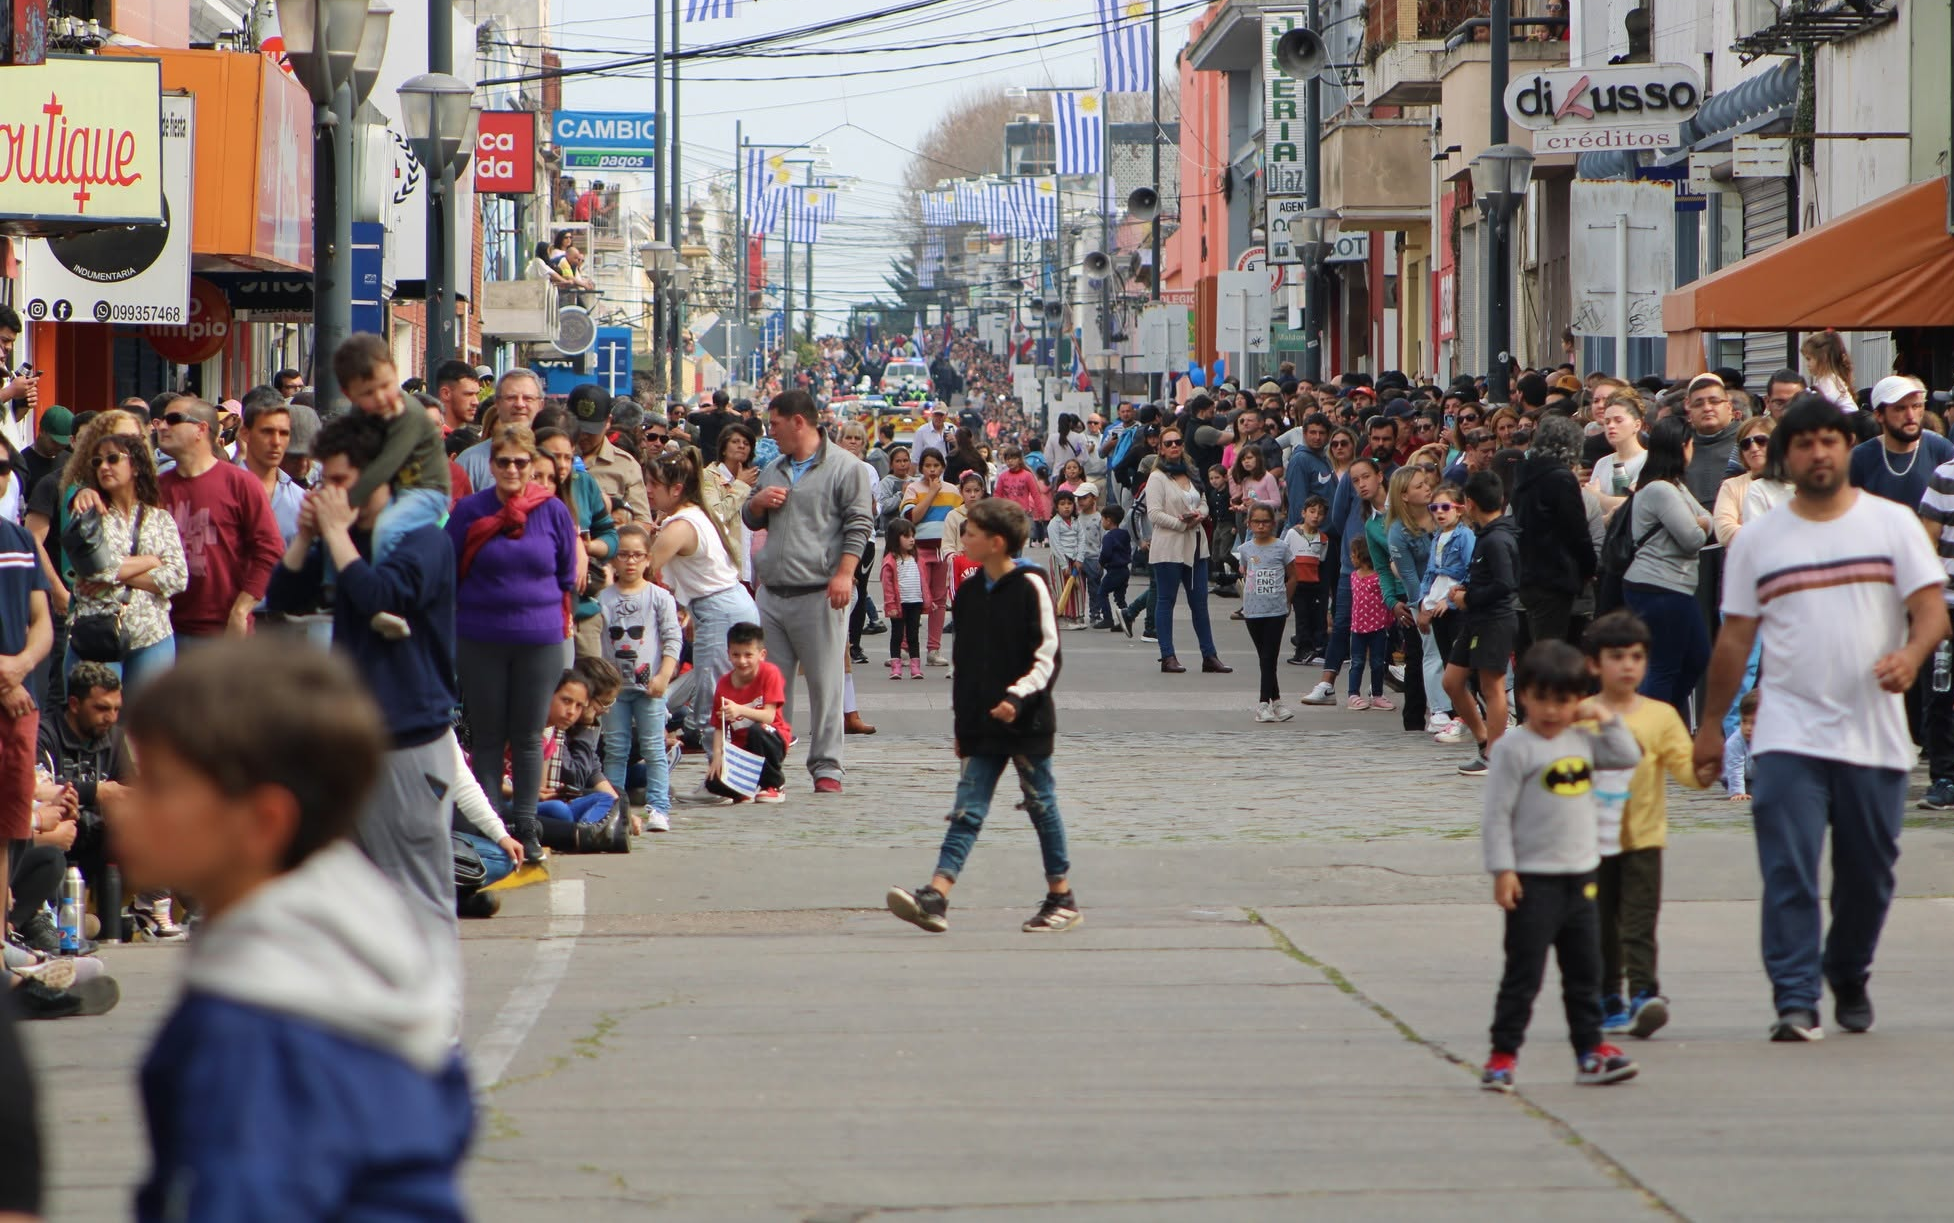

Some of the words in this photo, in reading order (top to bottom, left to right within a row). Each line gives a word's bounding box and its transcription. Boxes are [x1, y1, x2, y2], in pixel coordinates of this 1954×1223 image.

[170, 112, 187, 138] fiesta
[476, 132, 514, 151] ca
[1547, 131, 1670, 148] créditos
[477, 156, 513, 178] da
[575, 155, 644, 168] redpagos
[73, 264, 136, 281] INDUMENTARIA
[112, 304, 180, 322] 099357468
[1257, 586, 1274, 594] ENT
